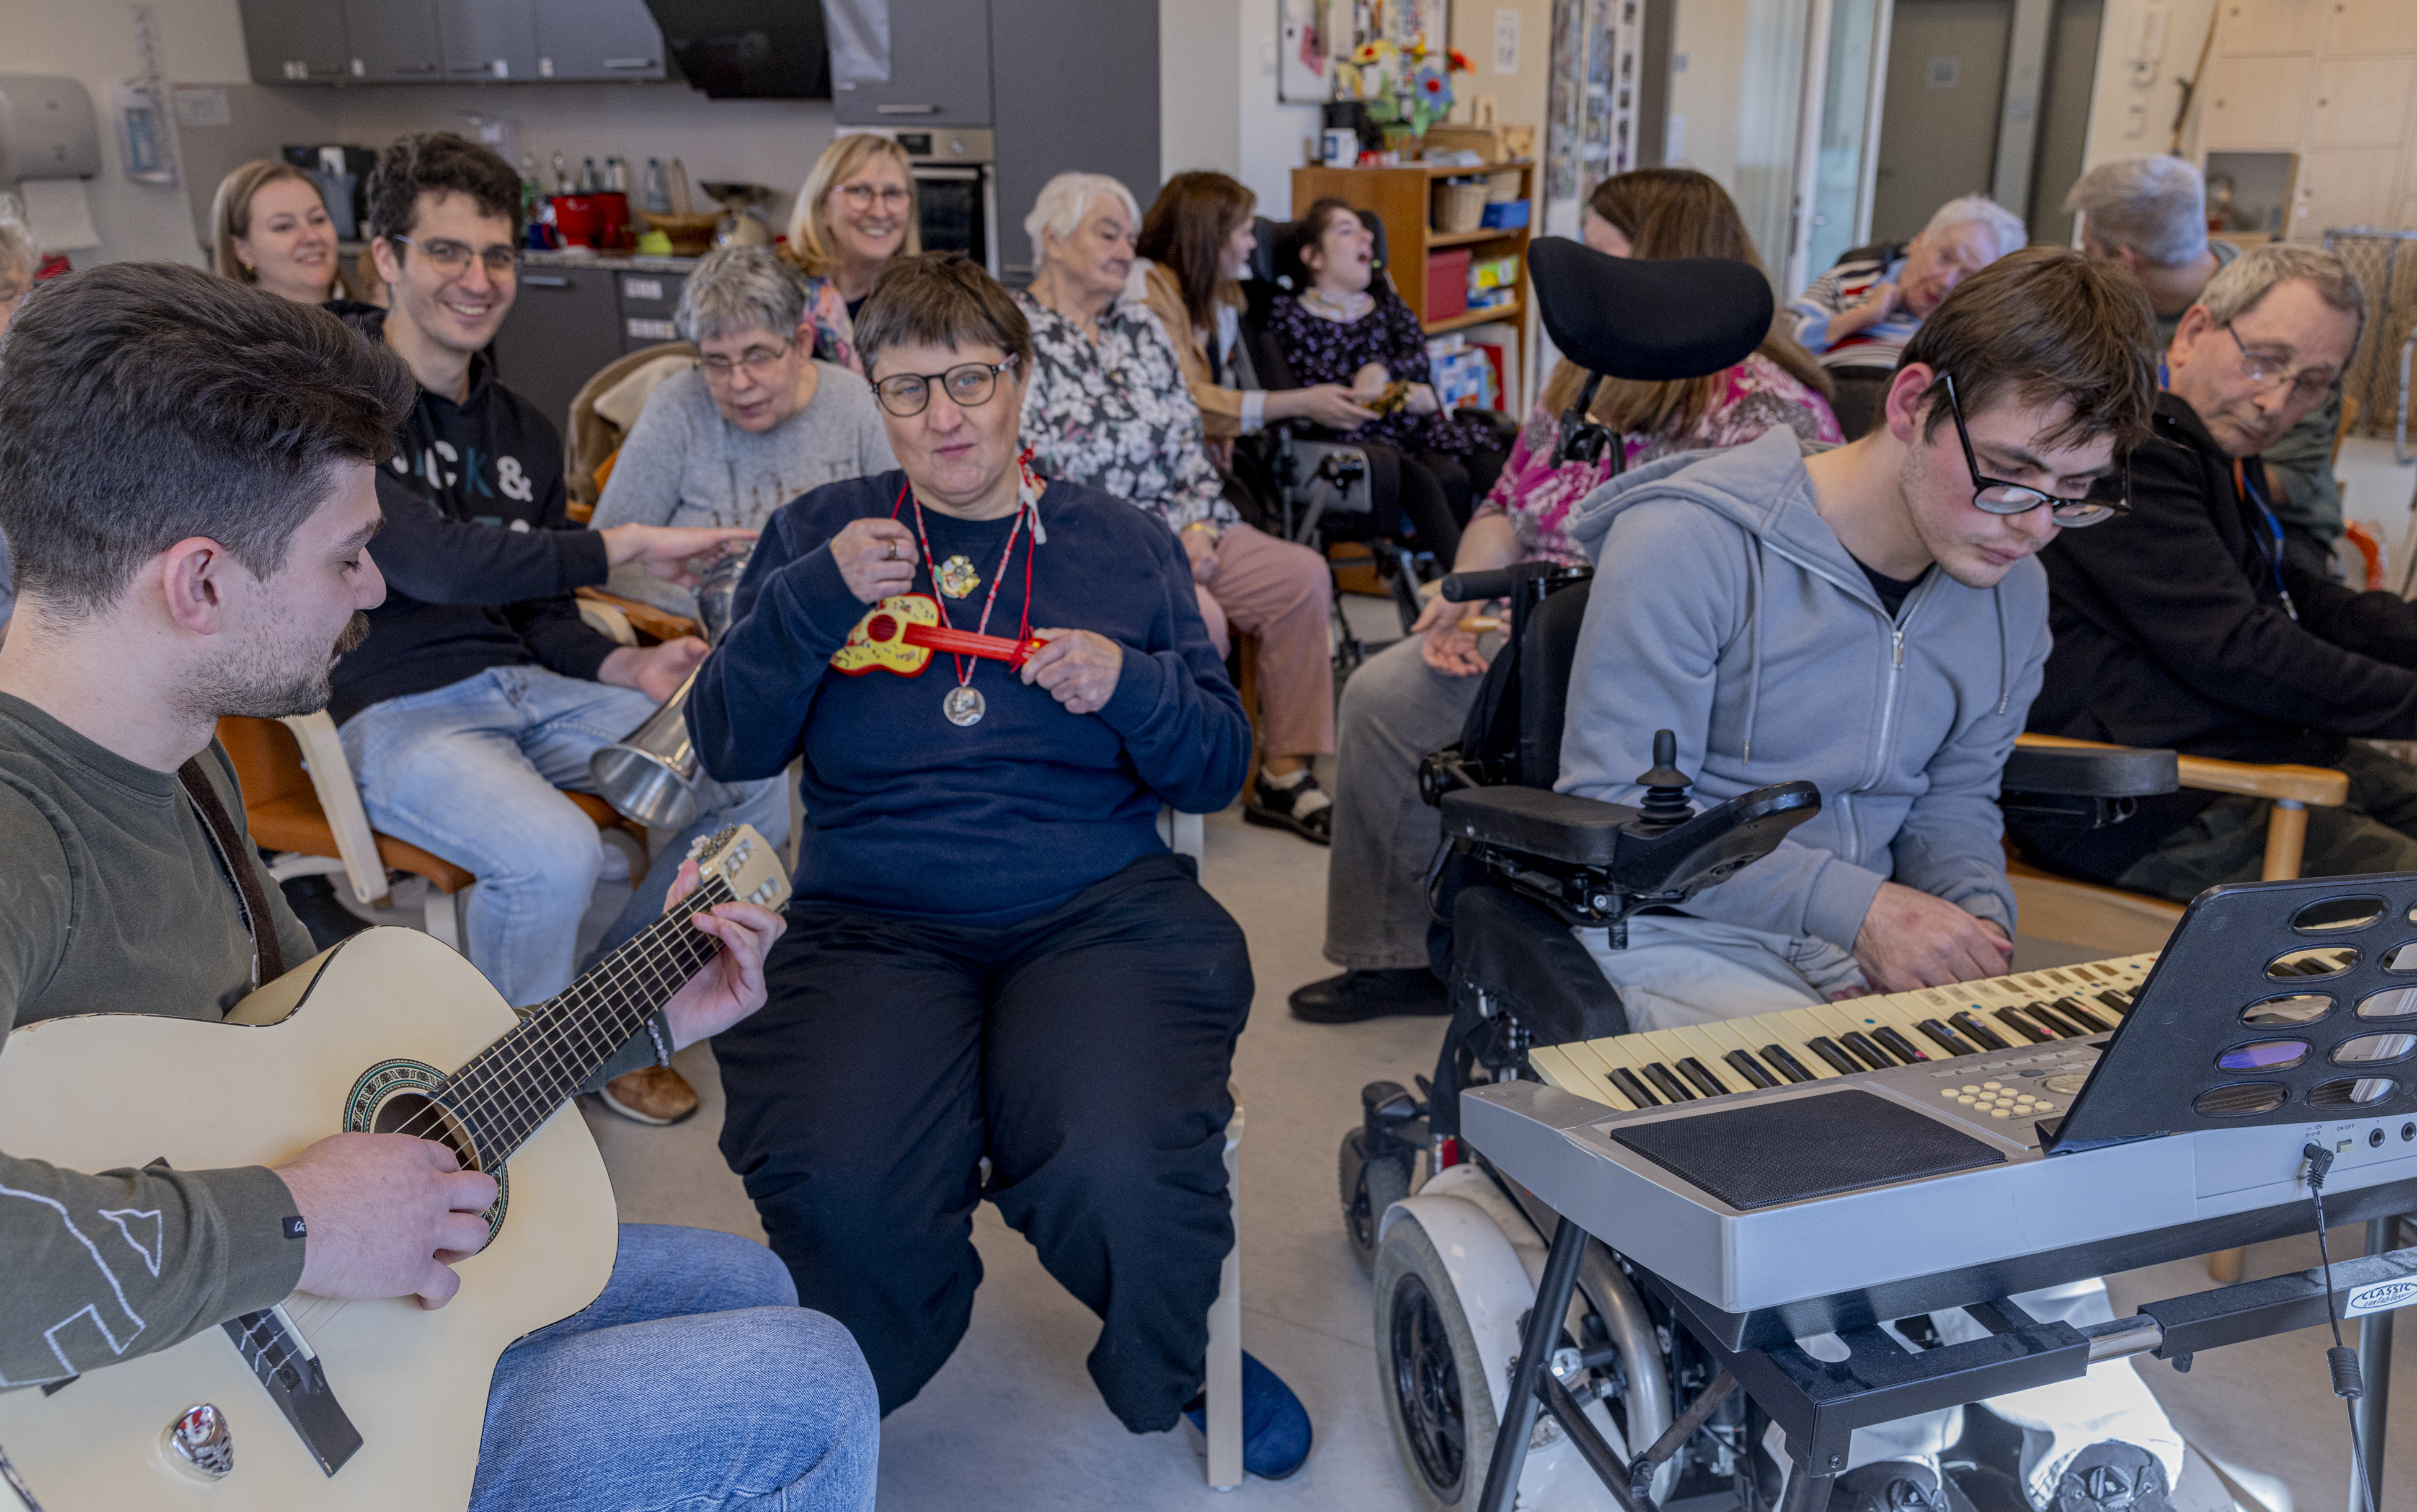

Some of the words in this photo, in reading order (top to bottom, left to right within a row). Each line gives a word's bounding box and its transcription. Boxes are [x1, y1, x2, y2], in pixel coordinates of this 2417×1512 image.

[497, 455, 534, 503] &
[2336, 1123, 2355, 1131] ON/OFF
[2362, 1283, 2411, 1299] CLASSIC
